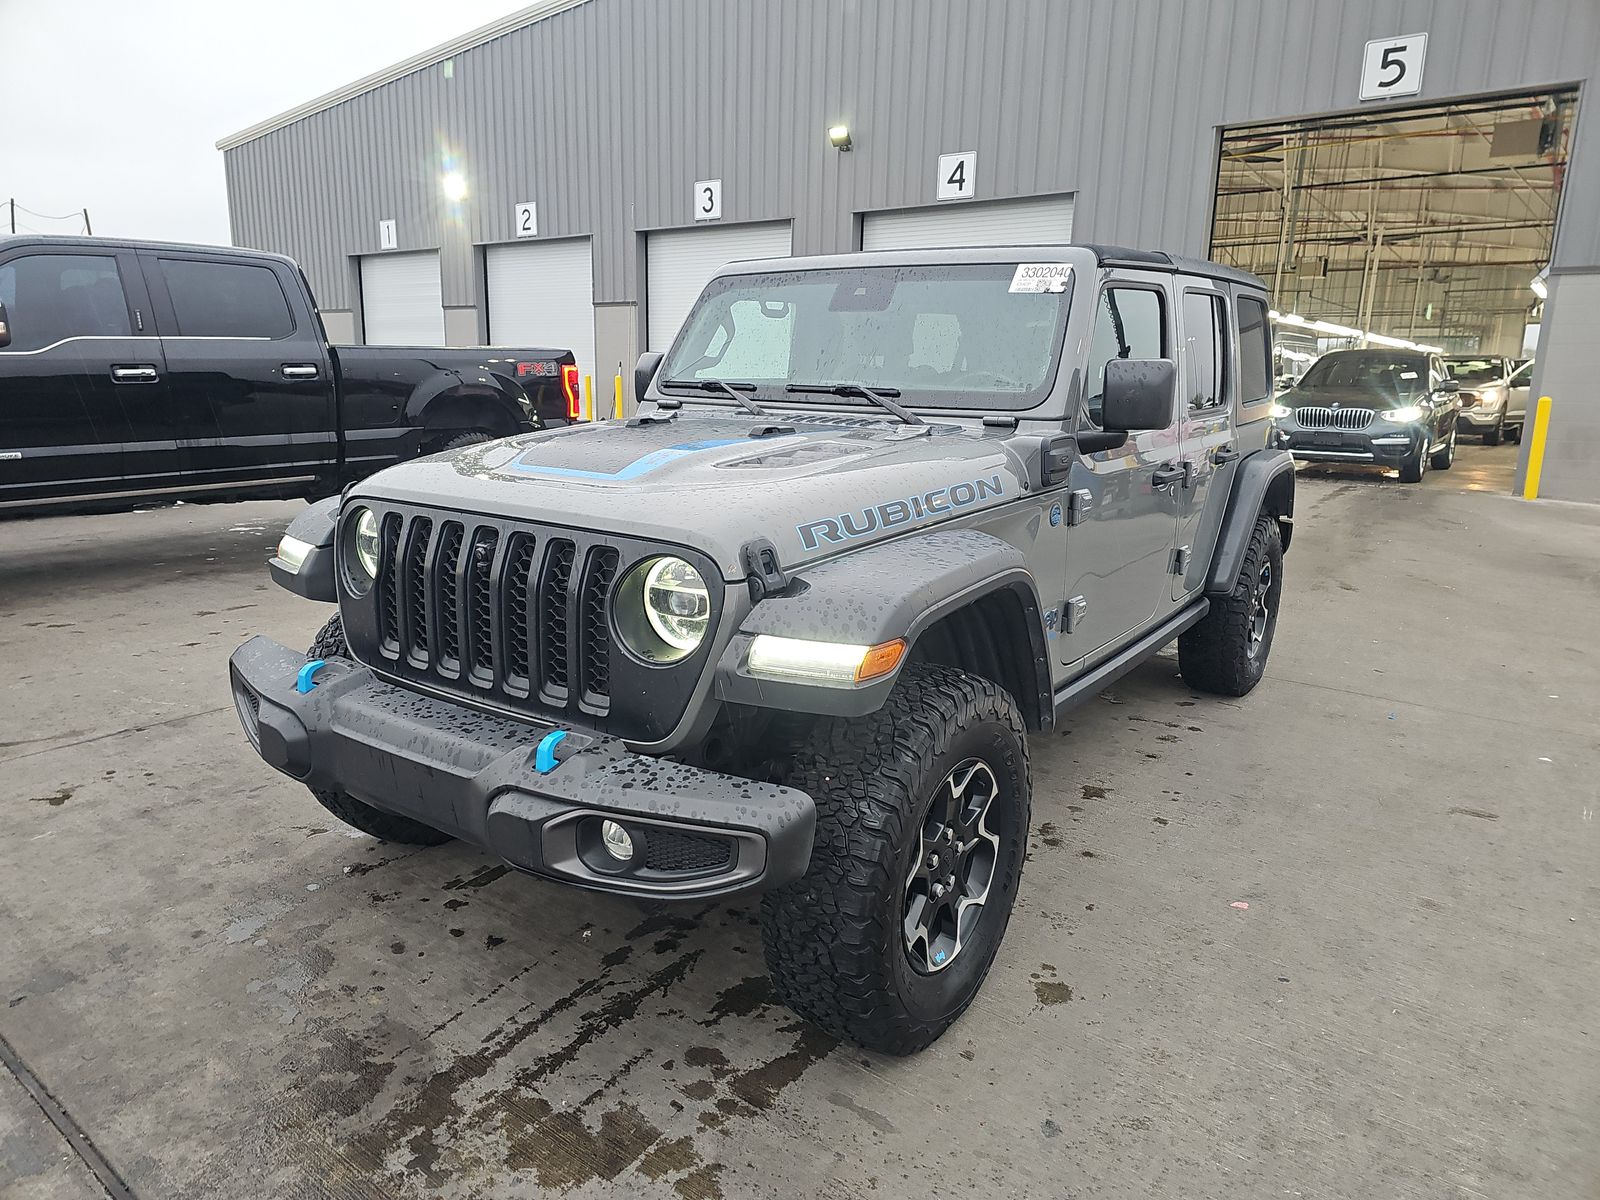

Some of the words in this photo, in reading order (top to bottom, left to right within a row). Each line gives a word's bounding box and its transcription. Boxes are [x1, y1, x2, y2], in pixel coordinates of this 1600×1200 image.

[1377, 45, 1407, 88] 5
[947, 160, 965, 191] 4
[702, 187, 714, 213] 3
[521, 208, 531, 231] 2
[386, 224, 391, 245] 1
[517, 361, 558, 376] FX4
[797, 474, 1004, 551] RUBICON
